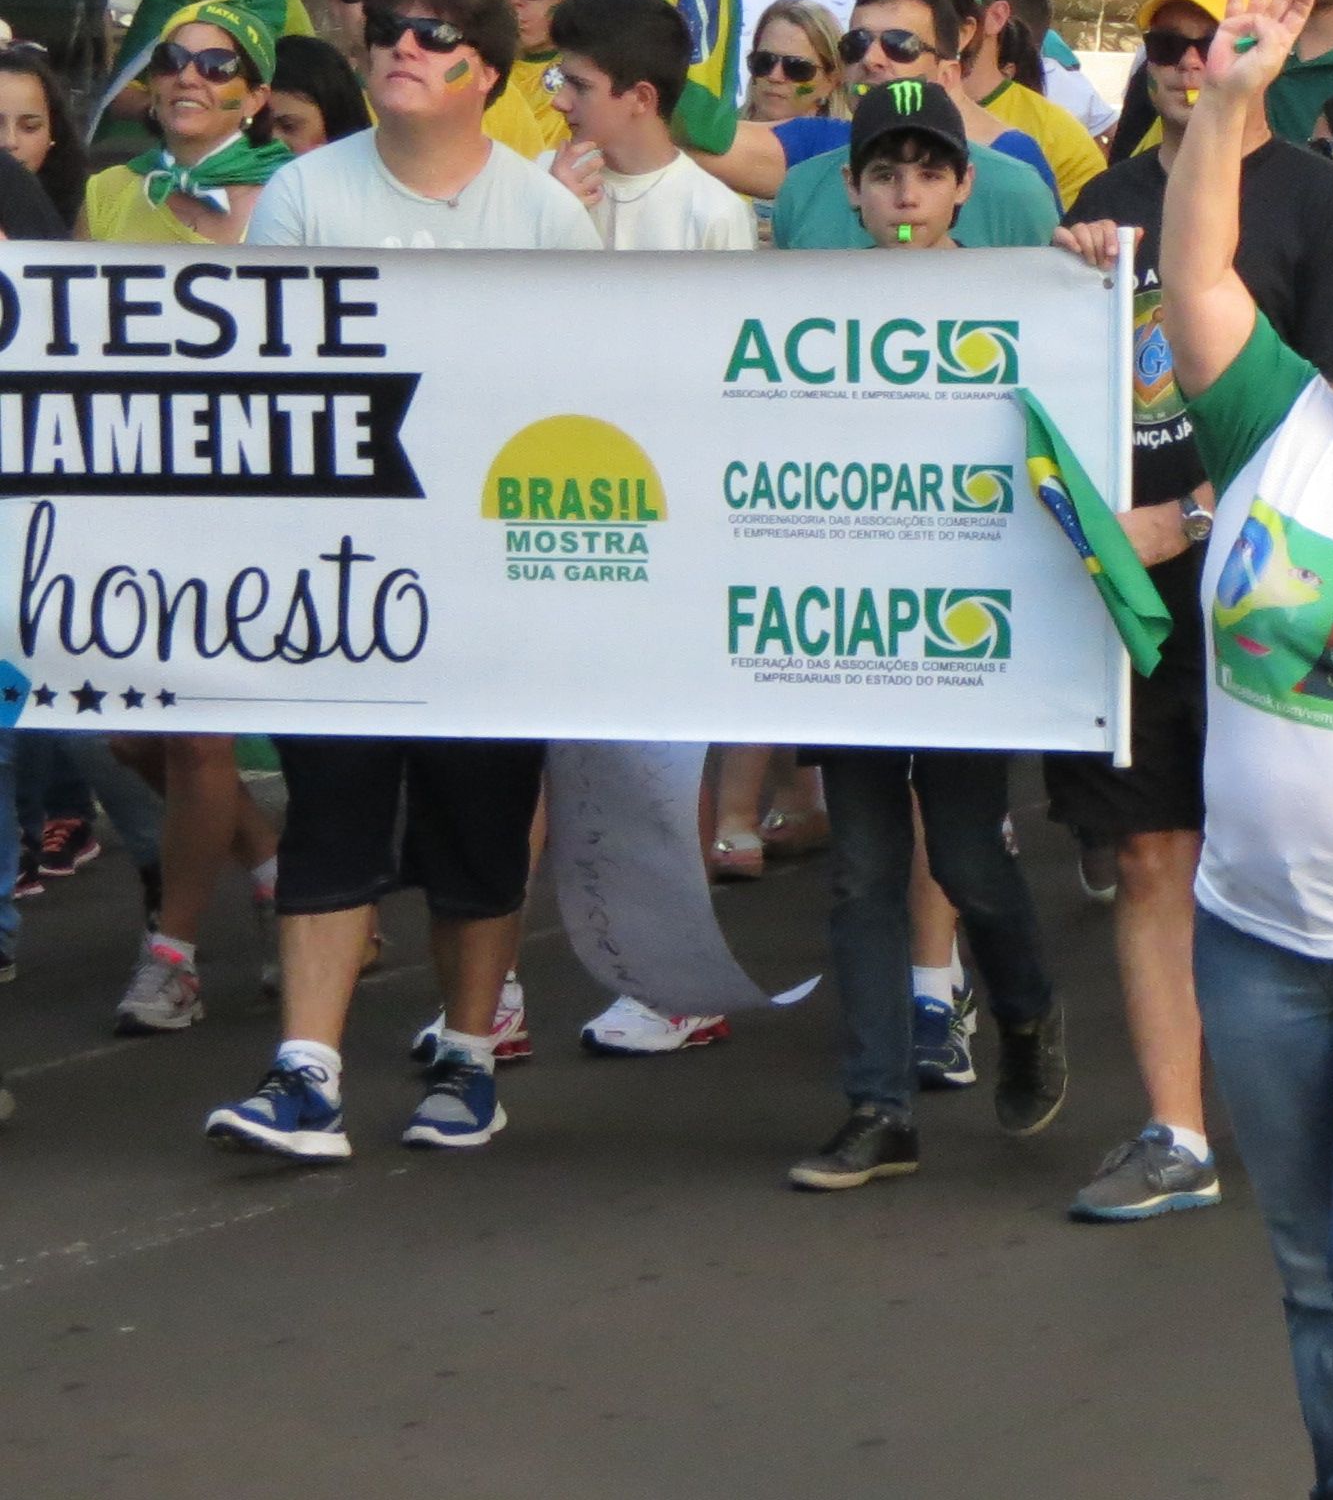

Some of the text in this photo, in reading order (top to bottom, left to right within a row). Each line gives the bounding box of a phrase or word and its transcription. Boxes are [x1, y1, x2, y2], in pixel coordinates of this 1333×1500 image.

[0, 263, 387, 360] TESTE
[723, 317, 931, 386] ACIG
[722, 387, 788, 401] ASSOCIAÇÃO
[790, 389, 849, 401] COMERCIAL
[852, 390, 859, 400] E
[861, 390, 931, 401] EMPRESARIAL
[935, 391, 949, 401] DE
[723, 460, 946, 513] CACICOPAR
[728, 513, 1008, 528] COORDENADORIA DAS ASSOCIAÇÕES COMERCIAIS
[505, 530, 649, 555] MOSTRA
[733, 528, 740, 538] E
[744, 528, 826, 540] EMPRESARIAIS
[829, 529, 846, 540] DO
[848, 530, 896, 541] CENTRO
[898, 531, 935, 542] OESTE
[938, 531, 955, 542] DO
[18, 499, 430, 664] honesto
[506, 563, 649, 583] SUA GARRA
[727, 585, 920, 657] FACIAP
[731, 656, 1007, 674] FEDERAÇÃO DAS ASSOCIAÇÕES COMERCIAIS E
[754, 672, 985, 688] EMPRESARIAIS DO ESTADO DO PARANÁ
